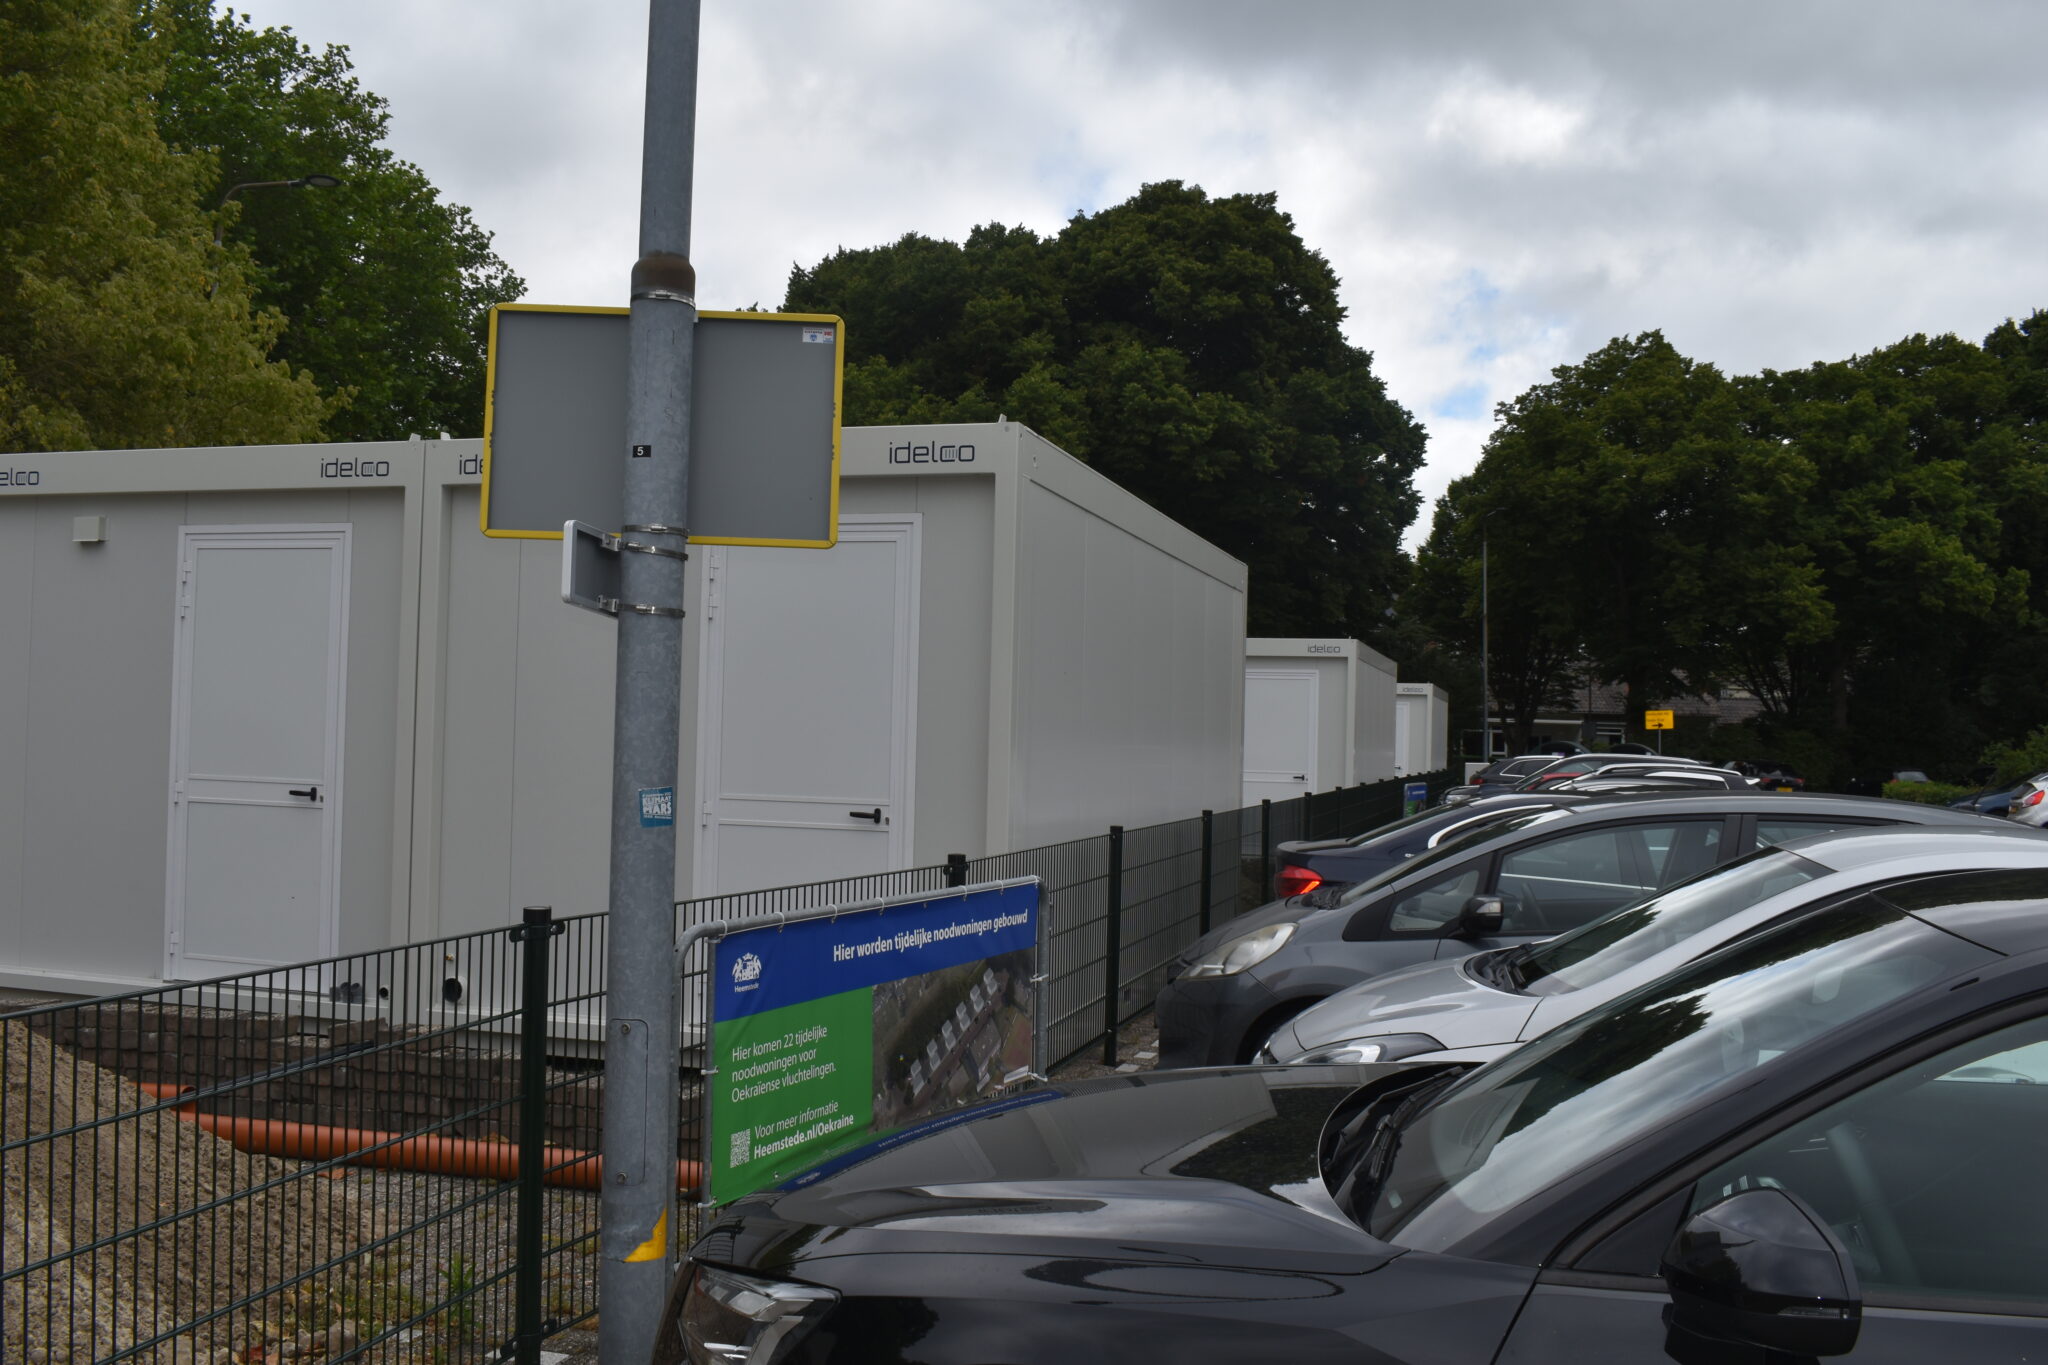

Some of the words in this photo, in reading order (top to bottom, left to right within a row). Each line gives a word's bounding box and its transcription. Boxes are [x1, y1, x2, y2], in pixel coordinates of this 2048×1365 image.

[320, 457, 390, 478] idelco
[637, 446, 644, 456] 5
[889, 440, 975, 464] idelco
[1307, 644, 1341, 654] idelco
[833, 944, 855, 962] Hier
[857, 935, 893, 957] worden
[894, 927, 932, 953] tijdelijke
[933, 917, 992, 942] noodwoningen
[993, 908, 1028, 933] gebouwd
[732, 1046, 751, 1063] Hier
[753, 1039, 782, 1057] komen
[783, 1033, 794, 1048] 22
[795, 1025, 828, 1047] tijdelijke
[731, 1078, 781, 1103] Oekraïense
[781, 1062, 837, 1088] vluchtelingen.
[732, 1055, 797, 1083] noodwoningen
[798, 1047, 817, 1063] voor
[754, 1124, 774, 1139] Voor
[776, 1115, 798, 1132] meer
[799, 1100, 839, 1124] informatie
[754, 1114, 854, 1160] Heemstede.nl/Oekraine
